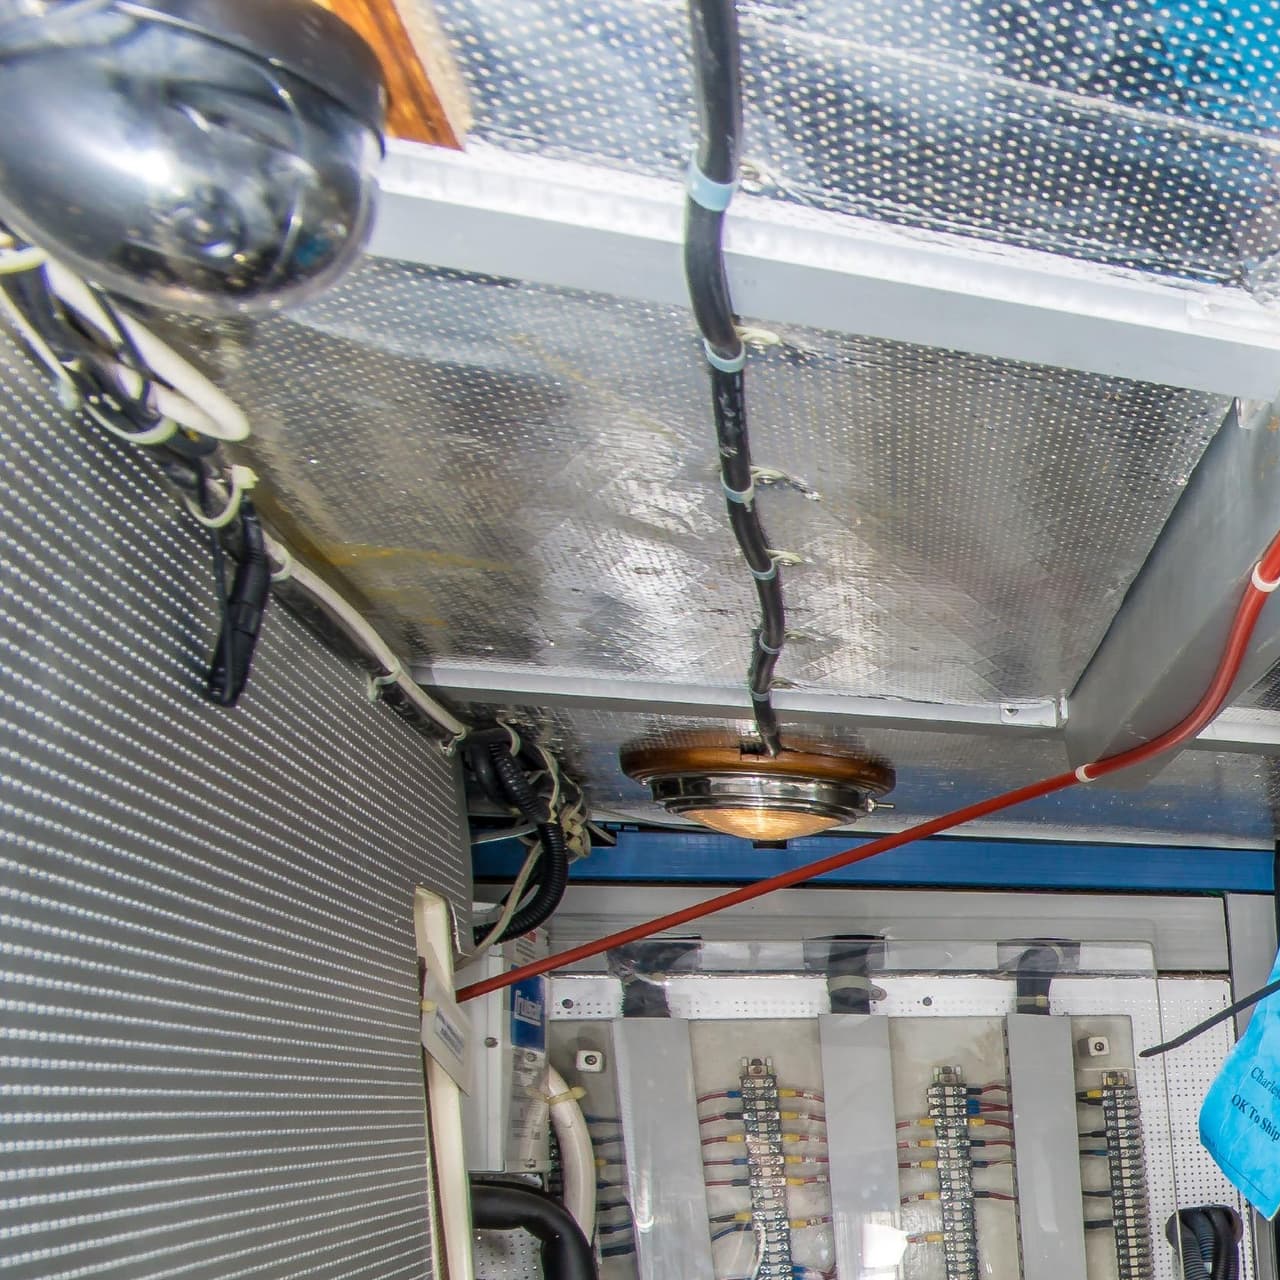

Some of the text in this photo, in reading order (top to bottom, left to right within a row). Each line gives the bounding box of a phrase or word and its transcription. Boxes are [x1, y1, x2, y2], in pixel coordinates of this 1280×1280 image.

[1232, 1094, 1280, 1142] OK To Ship
